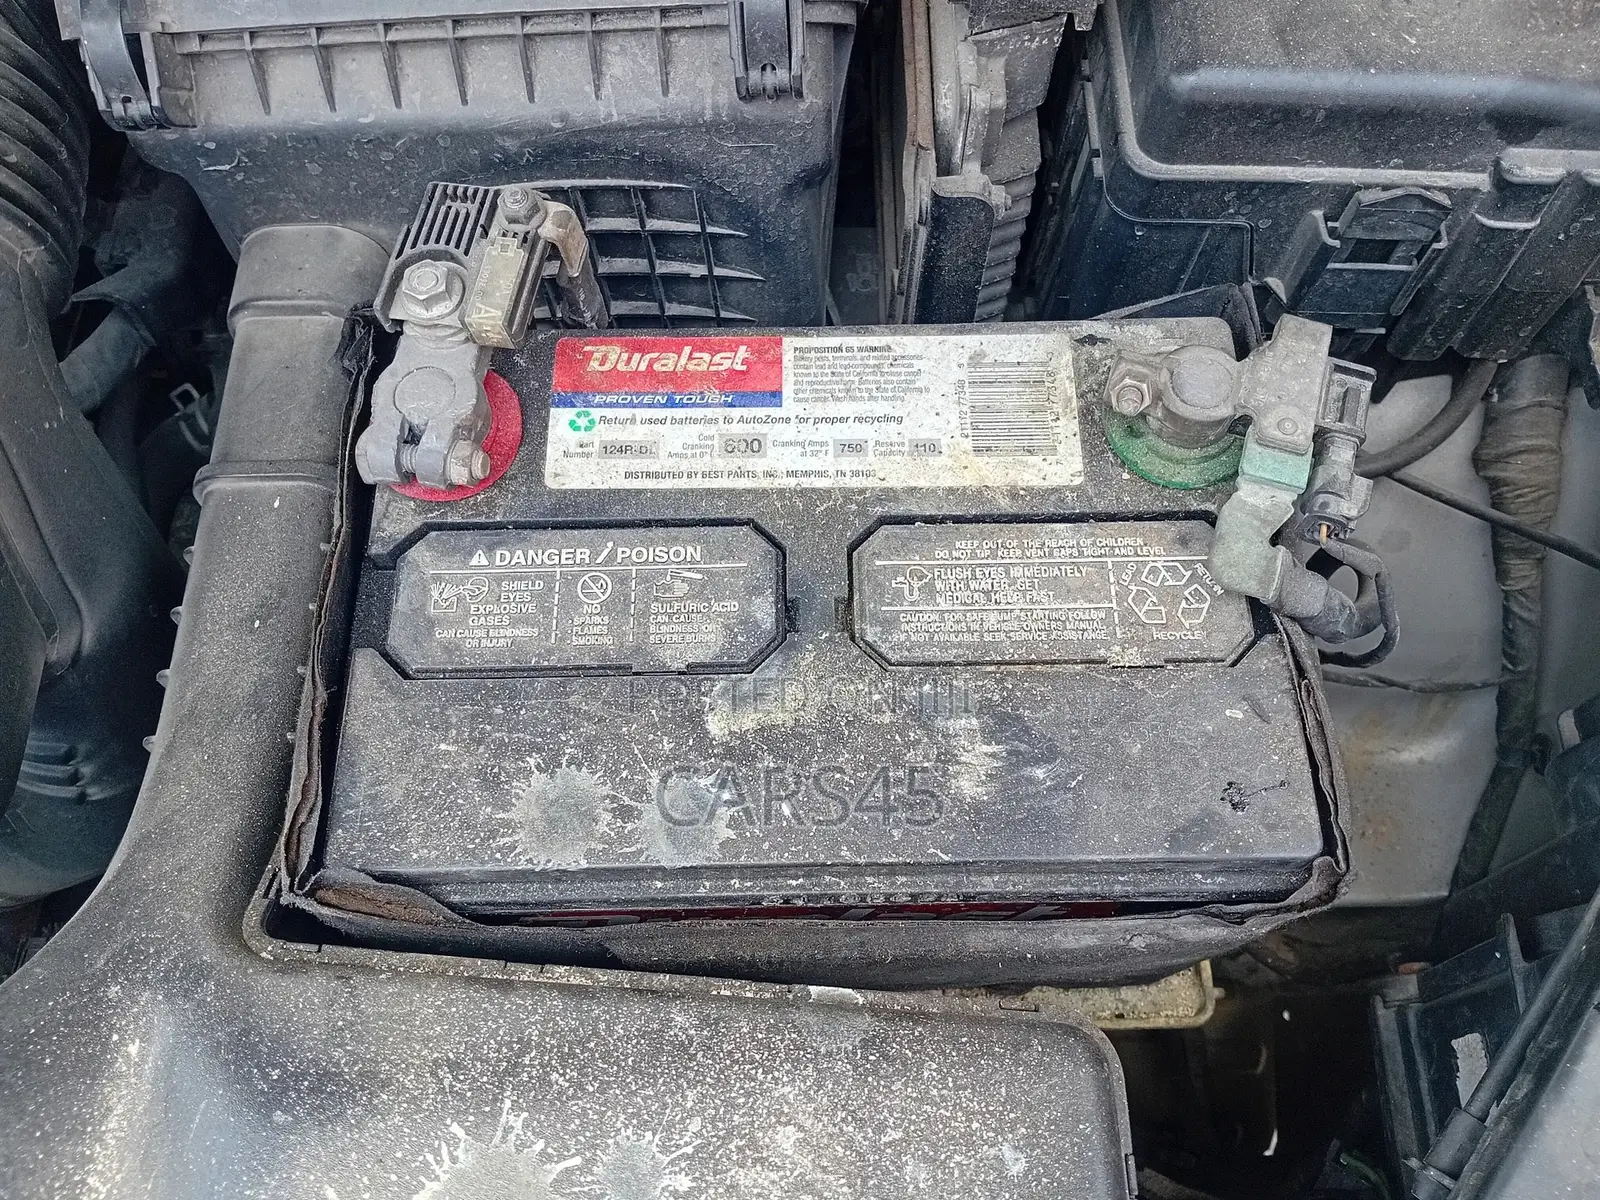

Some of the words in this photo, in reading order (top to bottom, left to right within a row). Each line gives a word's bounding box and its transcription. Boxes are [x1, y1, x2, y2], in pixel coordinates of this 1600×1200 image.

[793, 345, 843, 354] PROPOSITION
[582, 345, 751, 372] Duralast
[594, 395, 667, 405] PROVEN
[674, 394, 733, 403] TOUGH
[598, 415, 637, 426] Return
[640, 416, 668, 425] used
[670, 414, 720, 425] batteries
[723, 415, 735, 425] to
[736, 414, 792, 425] AutoZone
[813, 415, 851, 427] proper
[853, 413, 904, 425] recycling
[698, 433, 715, 441] Cold
[772, 440, 806, 449] Cranking
[808, 440, 829, 449] Amps
[839, 443, 863, 453] 750
[876, 440, 905, 448] Reserve
[563, 451, 594, 459] Number
[667, 451, 688, 459] Amps
[873, 449, 906, 459] Capacity
[624, 471, 684, 480] DISTRIBUTED
[687, 471, 699, 479] BY
[701, 470, 724, 479] BEST
[835, 470, 847, 478] TN
[849, 469, 877, 478] 38103
[955, 540, 979, 549] KEEP
[983, 539, 1001, 549] OUT
[1006, 539, 1019, 548] OF
[1022, 539, 1042, 548] THE
[1045, 539, 1076, 548] REACH
[1080, 538, 1093, 547] OF
[1096, 537, 1144, 547] CHILDREN
[495, 549, 591, 566] DANGER
[616, 546, 701, 564] POISON
[935, 550, 949, 559] DO
[952, 549, 971, 558] NOT
[997, 549, 1022, 558] KEEP
[1025, 549, 1050, 557] VENT
[1084, 547, 1109, 556] TIGHT
[1114, 547, 1134, 556] AND
[1138, 546, 1166, 556] LEVEL
[934, 567, 972, 580] FLUSH
[975, 567, 1006, 579] EYES
[1009, 565, 1087, 578] IMMEDIATELY
[1120, 562, 1137, 586] LEAD
[1194, 562, 1225, 596] RETURN
[501, 580, 544, 591] SHIELD
[934, 580, 966, 592] WITH
[1016, 579, 1040, 591] GET
[500, 592, 532, 602] EYES
[936, 592, 988, 604] MEDICAL
[991, 592, 1022, 604] HELP
[1026, 591, 1056, 603] FAST
[470, 603, 537, 615] EXPLOSIVE
[583, 604, 601, 614] NO
[650, 602, 709, 614] SULFURIC
[712, 601, 739, 612] ACID
[469, 615, 511, 626] GASES
[573, 616, 610, 625] SPARKS
[650, 614, 669, 623] CAN
[672, 614, 703, 623] CAUSE
[944, 612, 964, 621] FOR
[966, 612, 990, 621] SAFE
[1020, 611, 1066, 621] STARTING
[1068, 610, 1106, 620] FOLLOW
[572, 626, 608, 635] FLAMES
[650, 625, 699, 634] BLINDNESS
[901, 622, 967, 632] INSTRUCTIONS
[970, 622, 982, 631] IN
[983, 621, 1021, 632] VEHICLE
[1023, 621, 1063, 631] OWNERS
[435, 630, 455, 638] CAN
[457, 629, 488, 638] CAUSE
[489, 628, 539, 637] BLINDNESS
[910, 632, 929, 641] NOT
[933, 632, 980, 641] AVAILABLE
[983, 631, 1008, 641] SEEK
[1010, 631, 1048, 641] SERVICE
[1152, 631, 1202, 640] RECYCLE
[465, 639, 480, 648] OR
[481, 638, 514, 648] INJURY
[572, 636, 614, 646] SMOKING
[650, 635, 685, 644] SEVERE
[686, 634, 717, 644] BURNS
